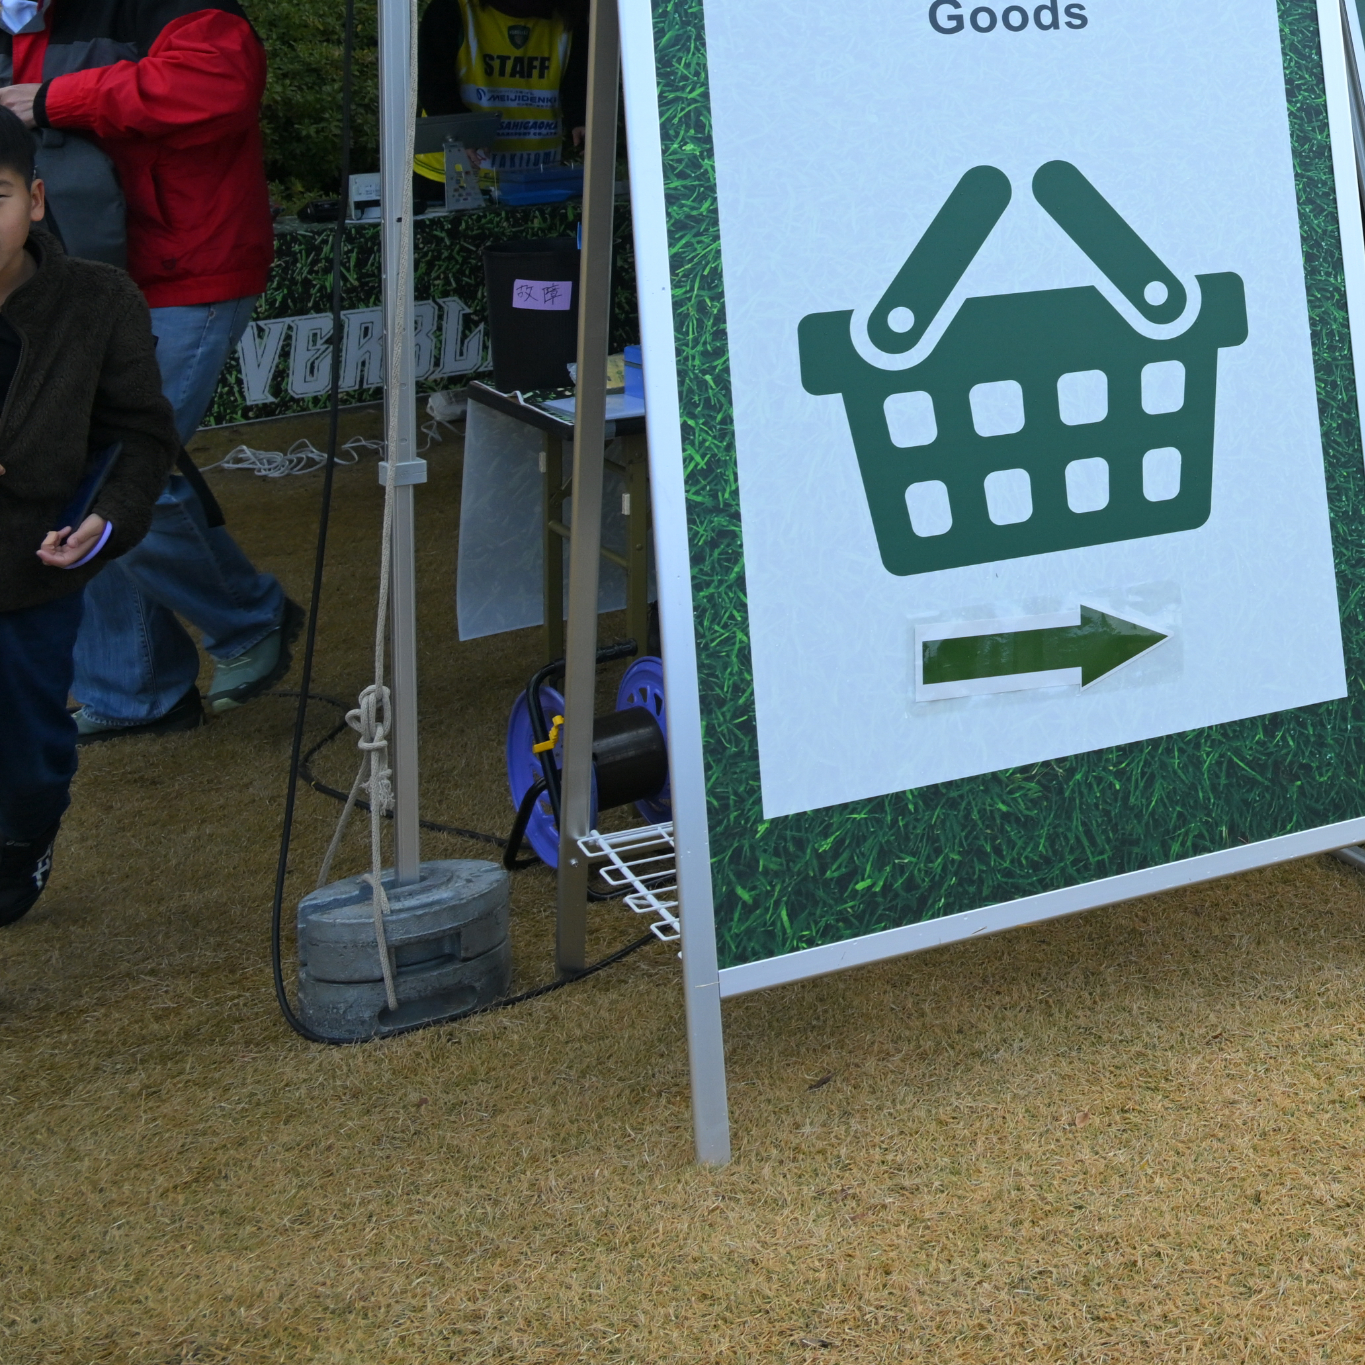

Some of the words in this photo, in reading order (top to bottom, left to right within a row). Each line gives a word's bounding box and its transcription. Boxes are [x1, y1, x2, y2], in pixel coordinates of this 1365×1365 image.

[483, 53, 551, 80] STAFF
[487, 94, 557, 104] MEIJIDENKI
[498, 120, 558, 132] SAHIGAOKA
[516, 282, 563, 305] 故障
[237, 297, 494, 405] VERBL
